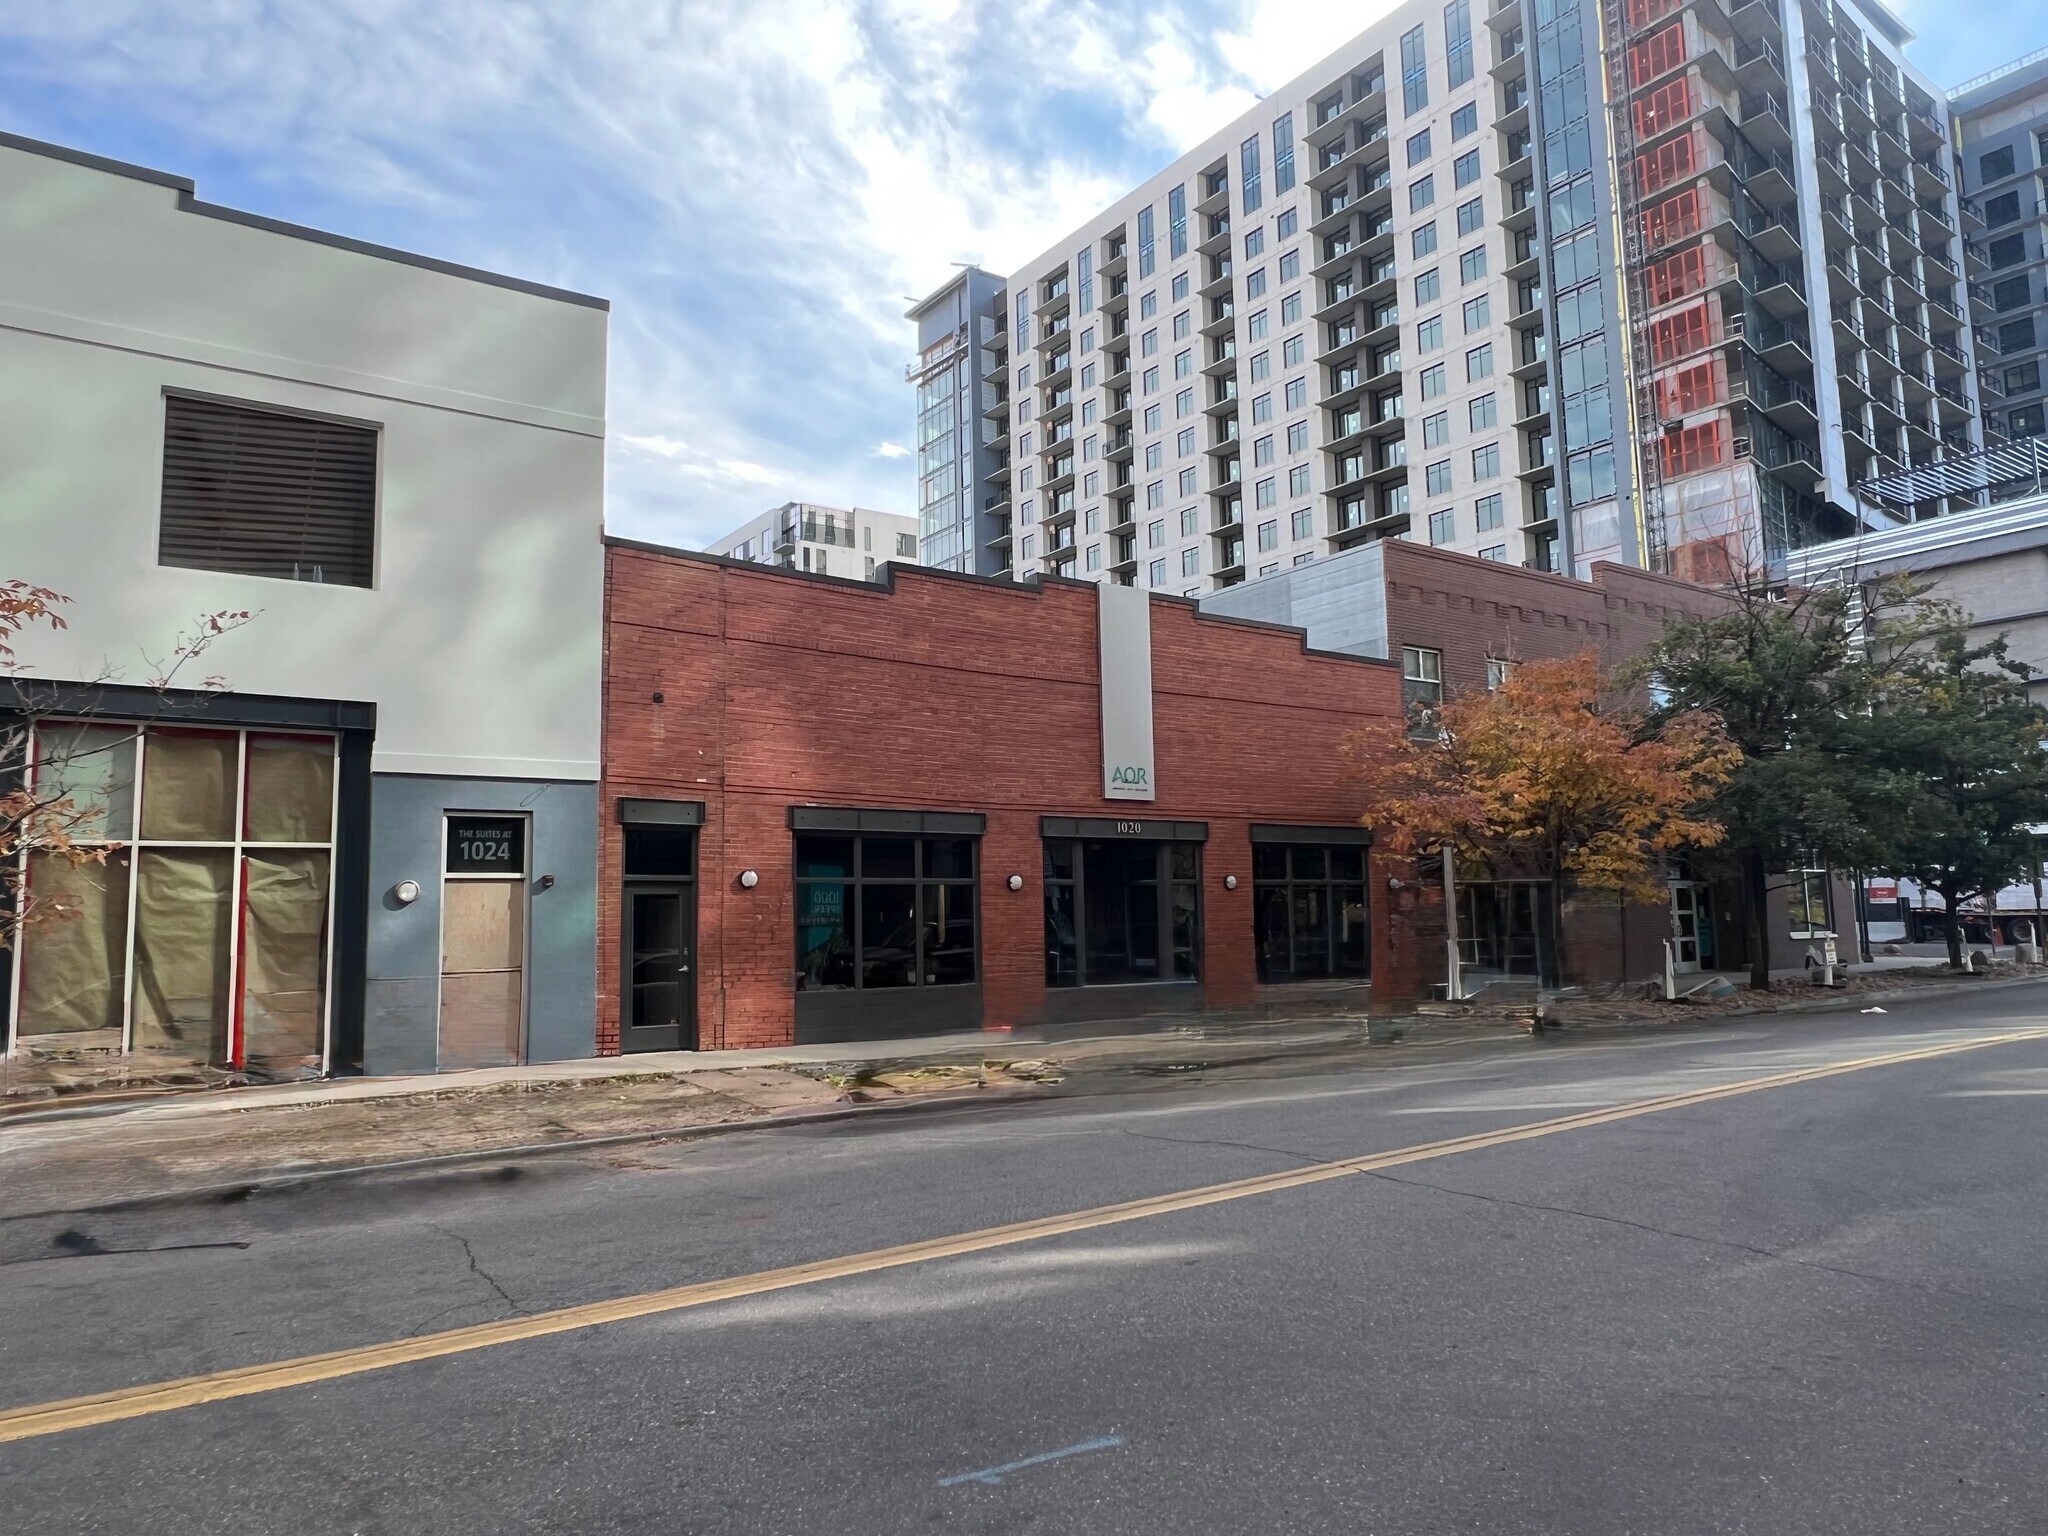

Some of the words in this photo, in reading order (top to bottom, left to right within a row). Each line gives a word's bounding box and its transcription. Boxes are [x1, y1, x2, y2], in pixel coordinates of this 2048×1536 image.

[1117, 822, 1141, 833] 1020
[459, 830, 473, 838] THE
[475, 830, 501, 838] SUITES
[502, 830, 513, 838] AT
[460, 841, 511, 860] 1024
